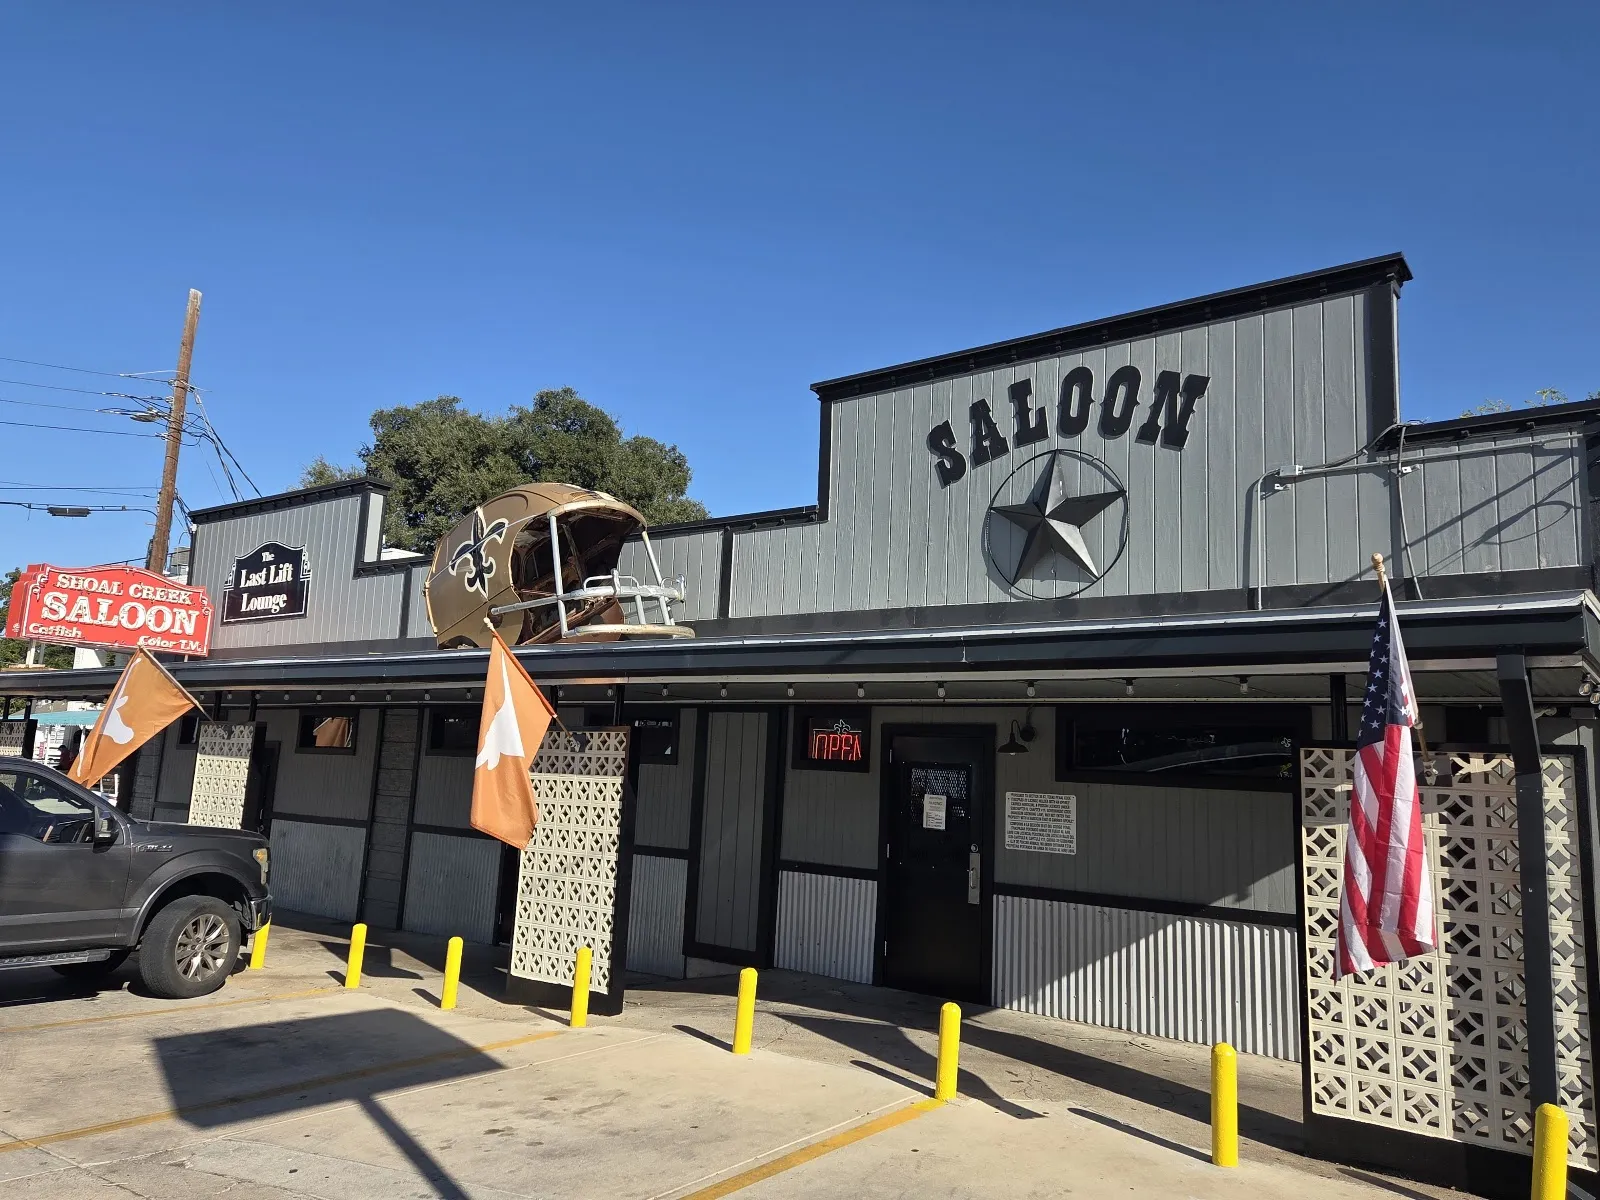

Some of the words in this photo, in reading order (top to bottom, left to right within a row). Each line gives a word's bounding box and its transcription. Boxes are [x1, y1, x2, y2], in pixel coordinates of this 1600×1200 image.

[926, 365, 1212, 490] SALOON
[262, 551, 276, 562] The
[240, 567, 267, 588] Last
[268, 562, 293, 585] Lift
[55, 573, 124, 596] SHOAL
[128, 583, 193, 606] CREEK
[41, 591, 200, 636] SALOON
[240, 592, 288, 613] Lounge
[29, 622, 83, 639] Catfish
[138, 635, 178, 648] Color
